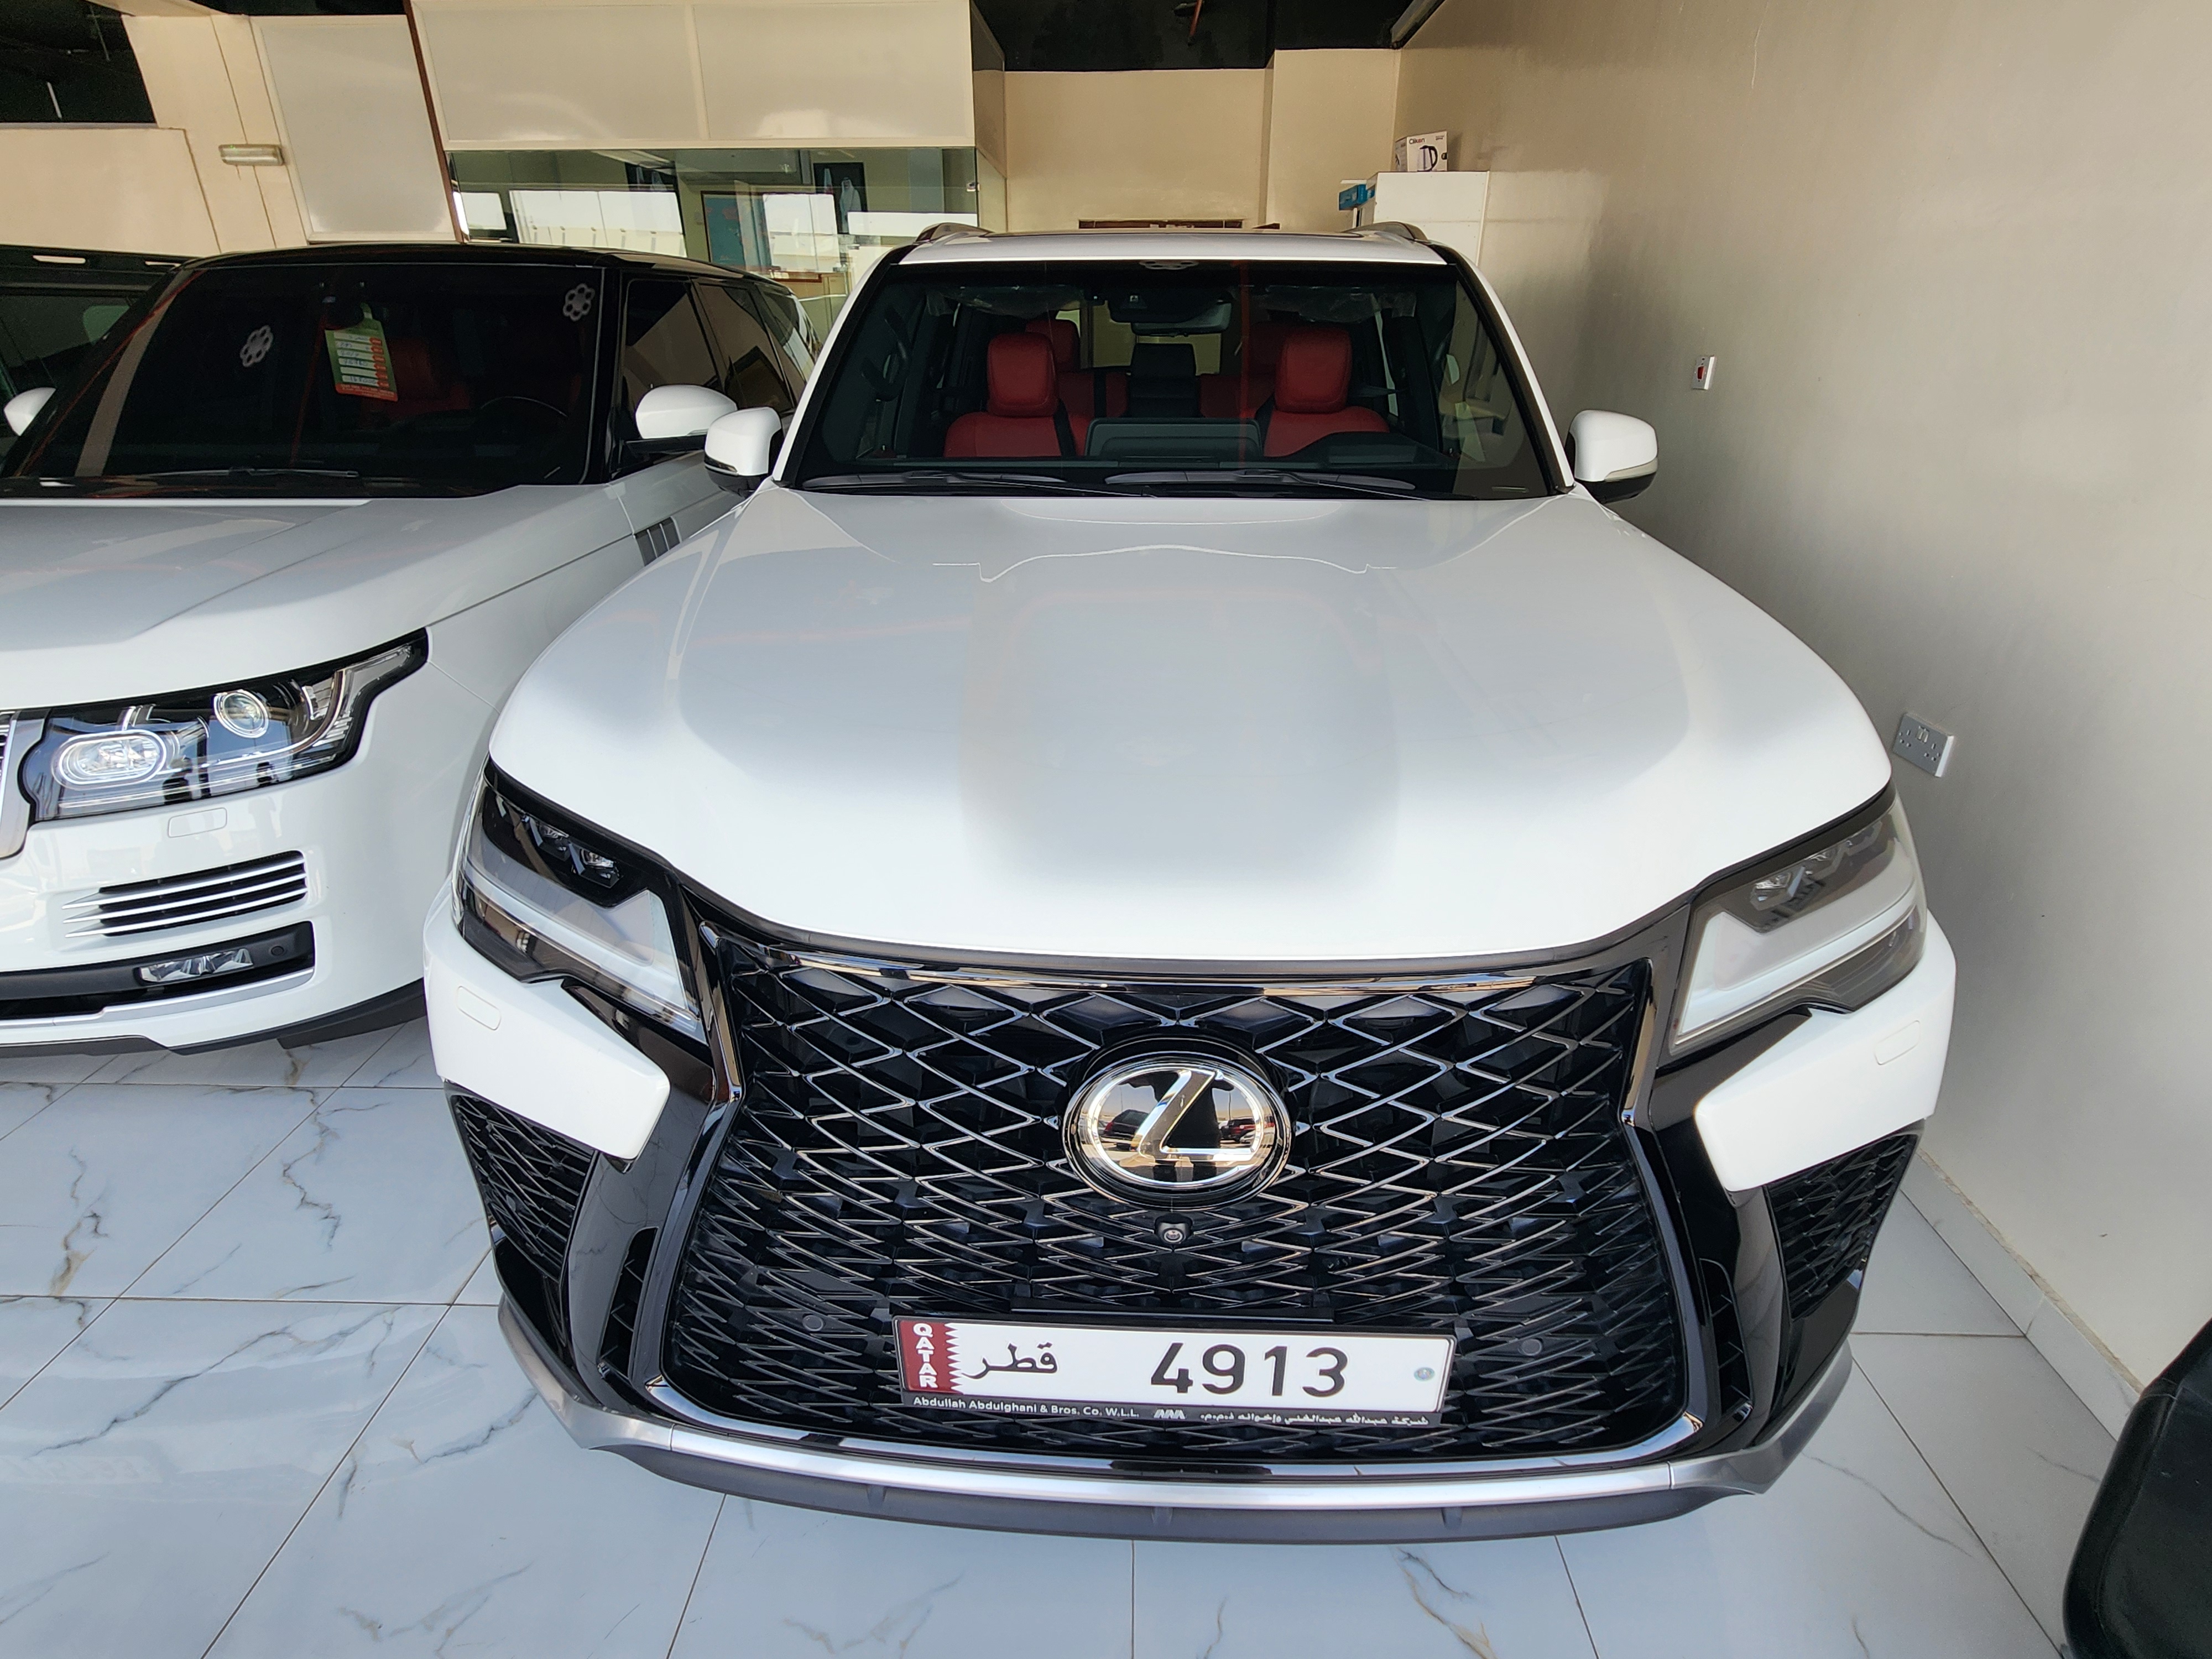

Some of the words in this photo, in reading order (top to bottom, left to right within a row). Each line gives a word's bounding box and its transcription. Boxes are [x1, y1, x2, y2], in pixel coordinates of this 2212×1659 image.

[913, 1323, 938, 1388] QATAR
[961, 1342, 1058, 1379] قطر
[1151, 1342, 1348, 1398] 4913
[913, 1397, 966, 1408] Abdullah
[969, 1400, 1037, 1413] Abdulghani
[1040, 1405, 1048, 1413] &
[1051, 1405, 1081, 1415] Bros.
[1083, 1407, 1102, 1416] Co.
[1105, 1407, 1139, 1417] W.L.L.
[1391, 1415, 1429, 1426] شركة
